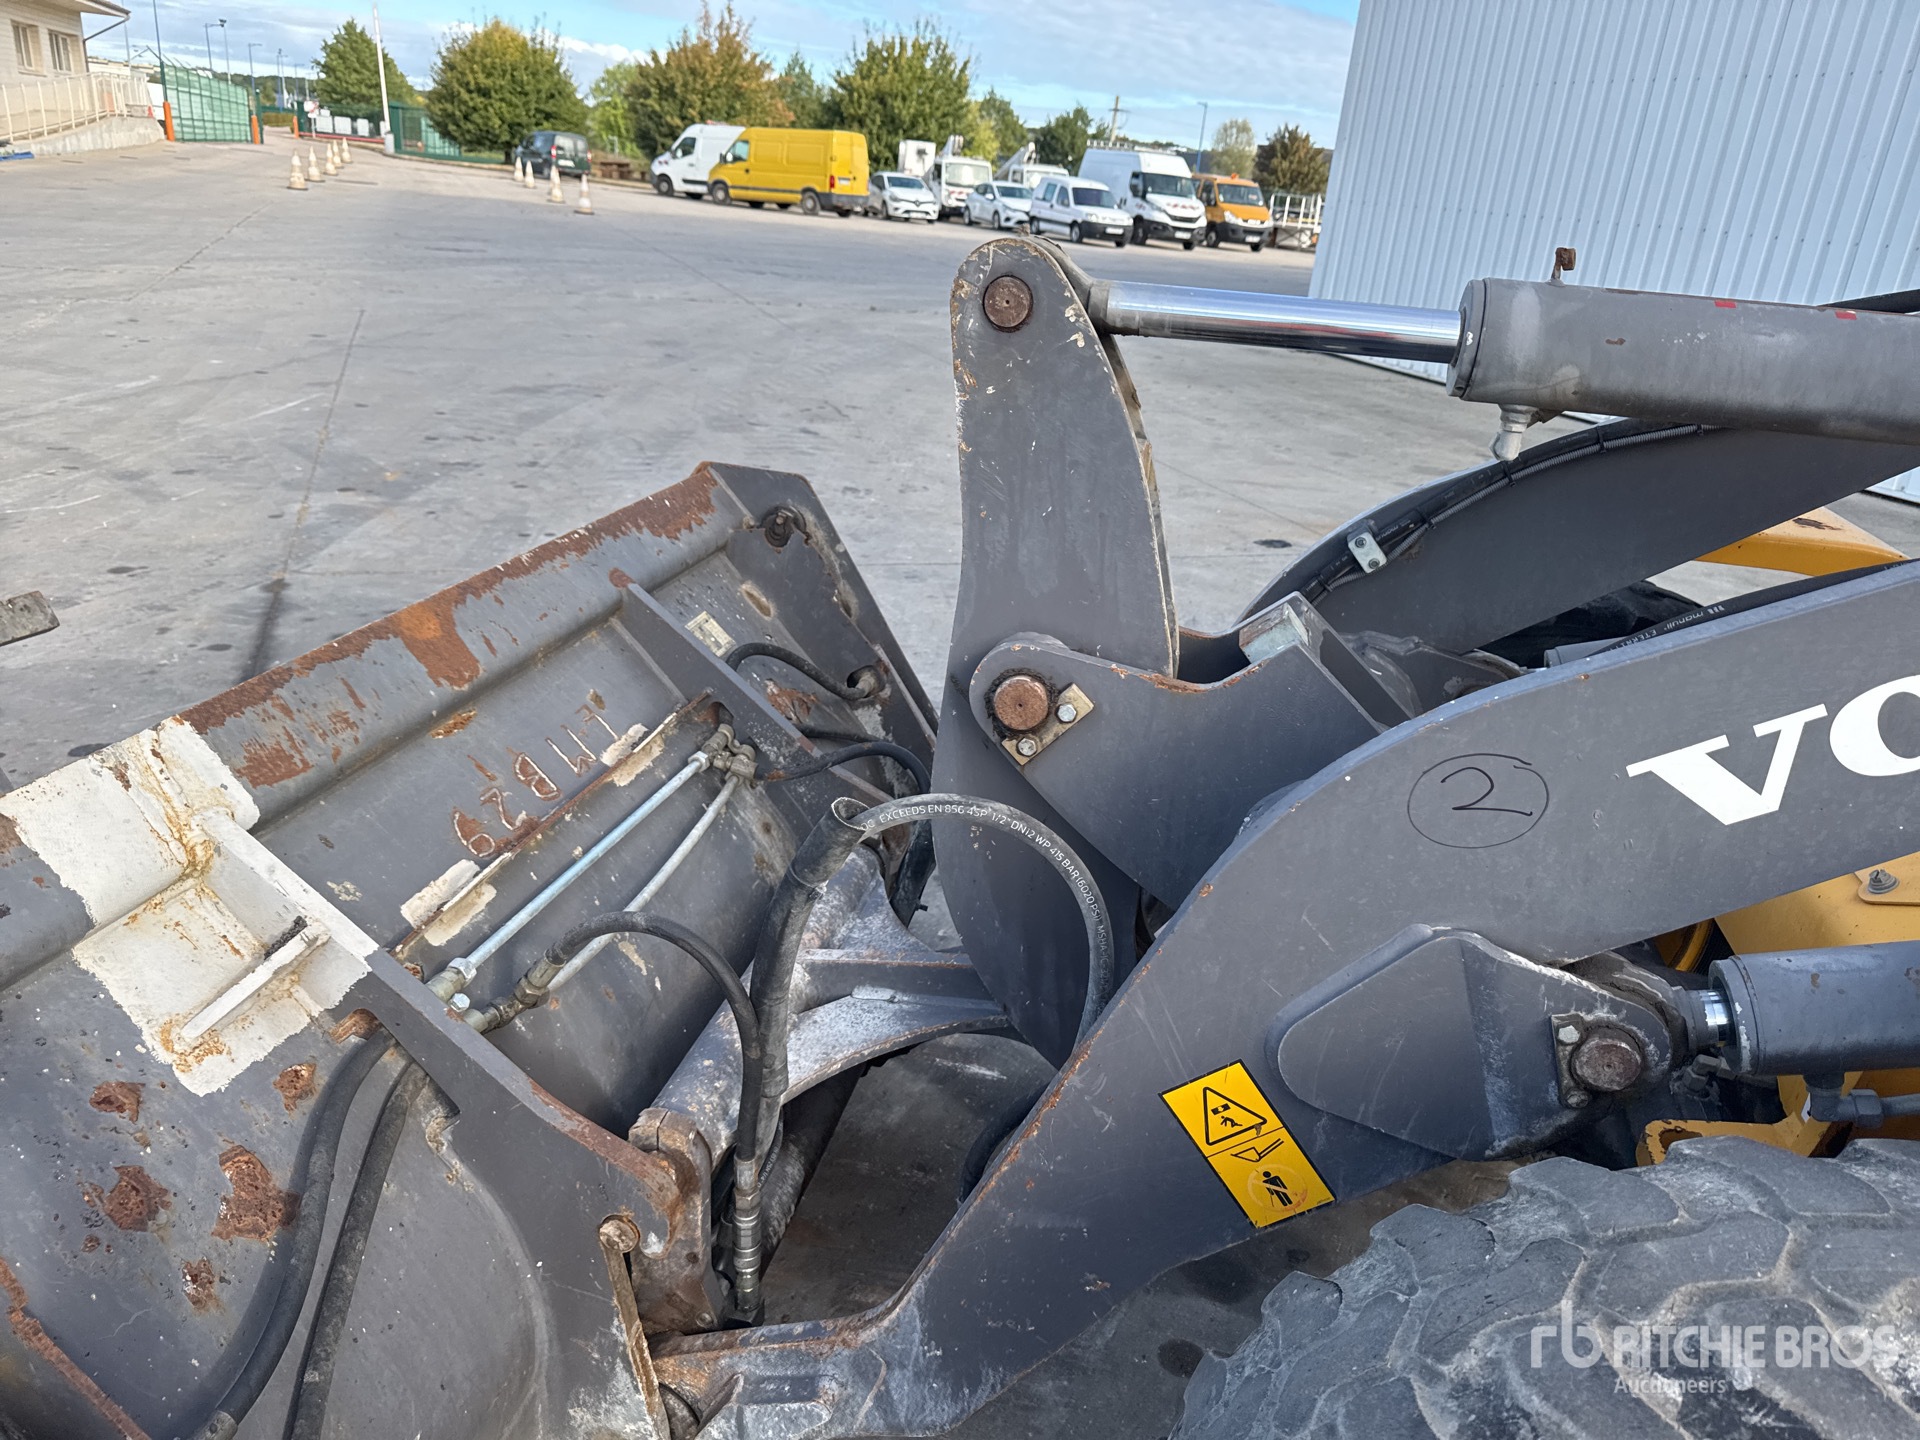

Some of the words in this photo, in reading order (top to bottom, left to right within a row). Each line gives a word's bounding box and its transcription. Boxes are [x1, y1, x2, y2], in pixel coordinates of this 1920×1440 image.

[1666, 611, 1703, 629] manuli
[1440, 767, 1533, 816] 2
[879, 806, 926, 823] EXCEEDS
[927, 804, 942, 814] EN
[944, 804, 965, 814] 856
[966, 805, 988, 818] 4SP
[1010, 820, 1036, 839] DN12
[1035, 834, 1051, 848] WP
[1049, 846, 1065, 861] 415
[1061, 858, 1080, 879] BAR
[1075, 877, 1095, 904] (6020
[1090, 903, 1102, 921] PSI)
